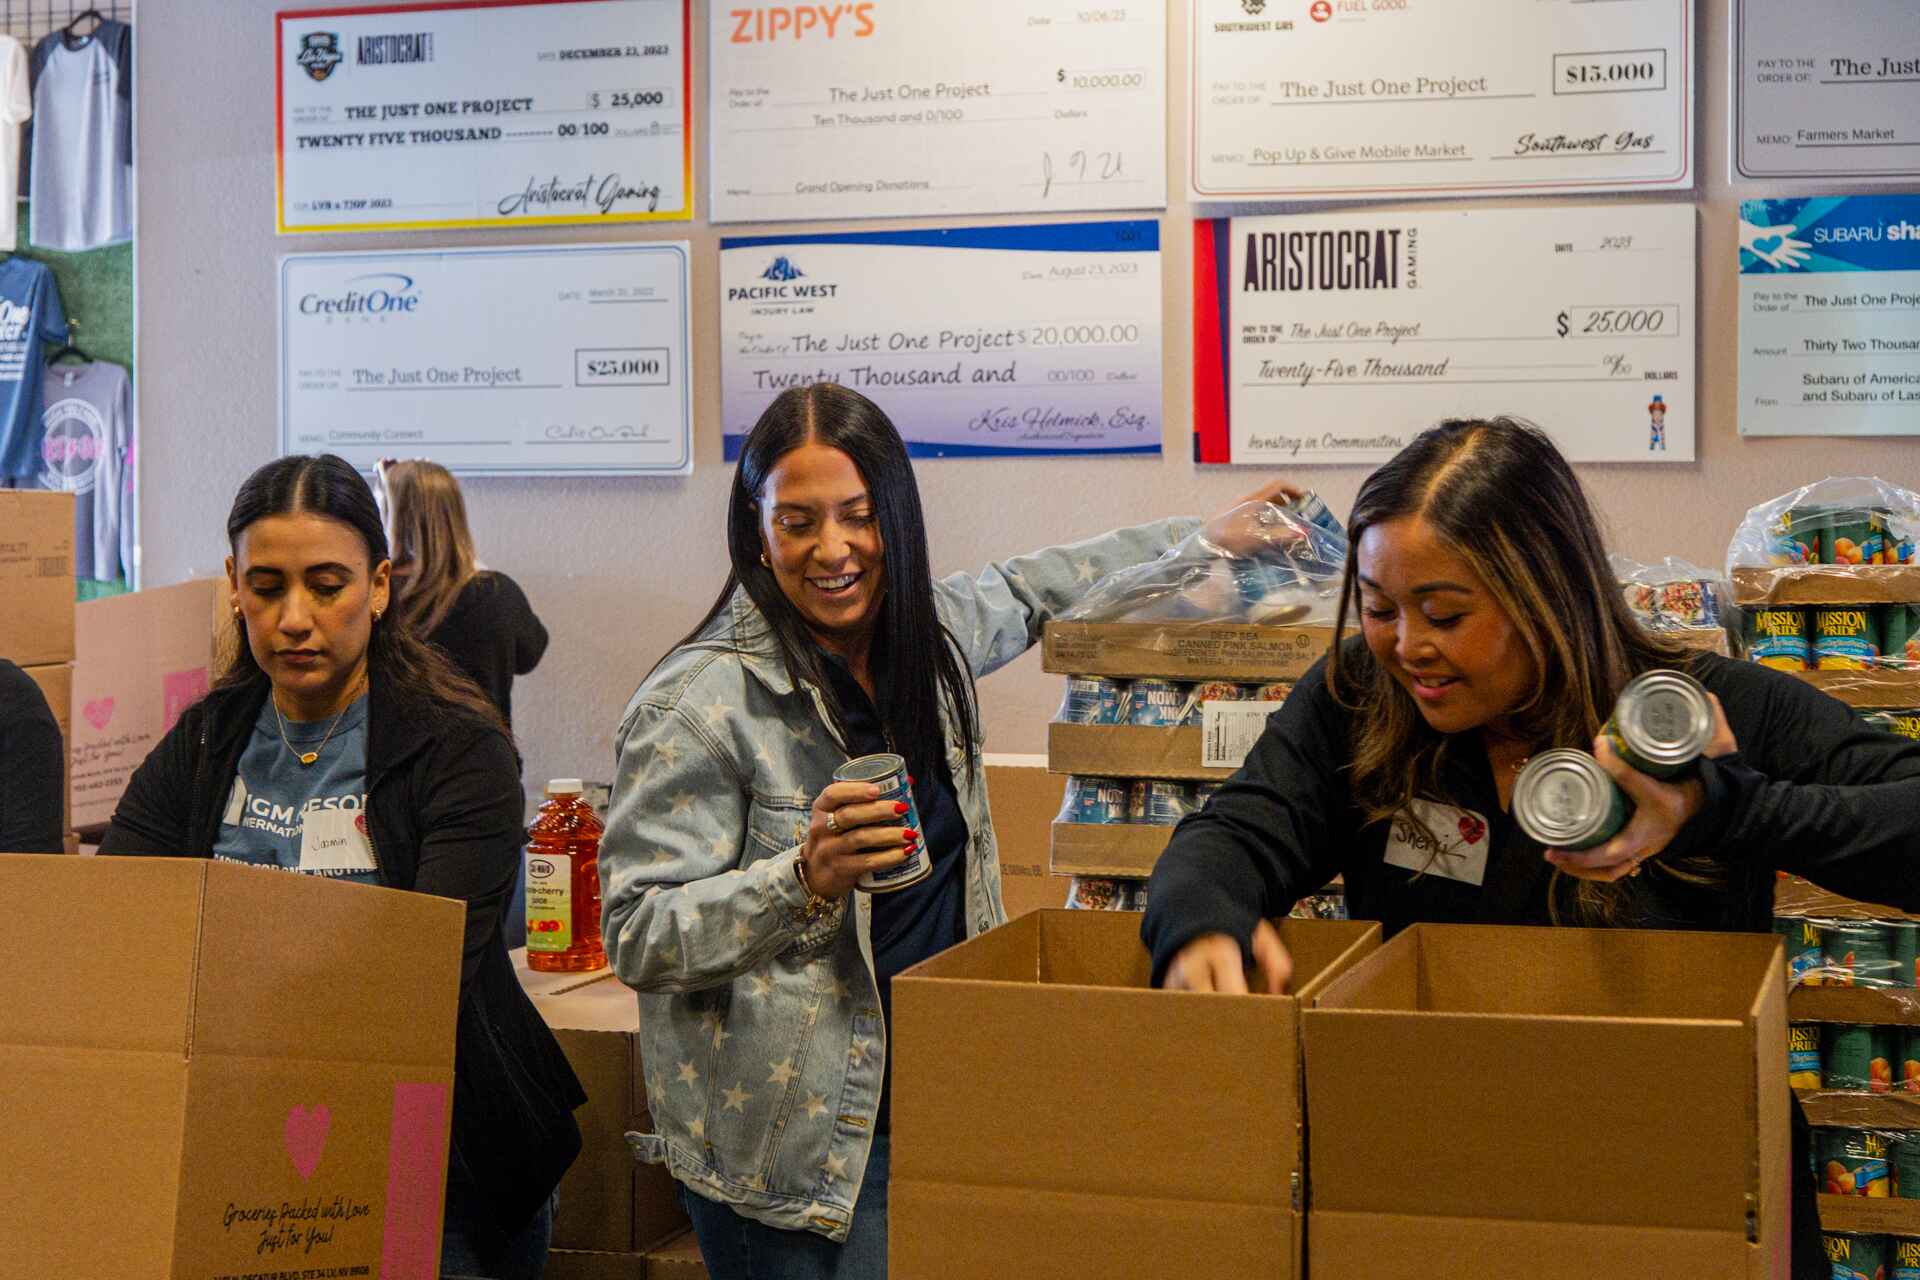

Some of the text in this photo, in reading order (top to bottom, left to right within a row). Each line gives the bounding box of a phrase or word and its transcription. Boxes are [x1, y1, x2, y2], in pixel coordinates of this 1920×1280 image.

[730, 3, 875, 43] ZIPPY'S
[356, 33, 426, 65] ARISTOCRAT
[560, 47, 622, 60] DECEMBER
[1758, 58, 1815, 68] PAY TO THE
[1830, 57, 1920, 76] The Just
[1057, 68, 1065, 82] $
[1757, 73, 1792, 83] ORDER
[829, 83, 991, 103] The Just One Project
[1280, 75, 1488, 98] The Just One Project
[344, 104, 377, 119] THE
[381, 103, 419, 120] JUST
[424, 102, 458, 117] ONE
[462, 97, 533, 115] PROJECT
[592, 93, 600, 108] $
[611, 92, 663, 108] 25,000
[813, 114, 835, 126] Ten
[838, 112, 897, 124] Thousand
[899, 110, 922, 122] and
[296, 127, 501, 149] TWENTY FIVE THOUSAND
[1514, 131, 1655, 155] Southwest Gas
[1797, 128, 1894, 141] Farmers Market
[1253, 142, 1466, 165] Pop Up & Give Mobile Market
[497, 173, 660, 215] Aristocrat Gaming
[795, 182, 826, 194] Grand
[830, 181, 874, 194] Opening
[876, 179, 929, 192] Donations
[1814, 225, 1882, 243] SUBARU
[1244, 228, 1418, 292] ARISTOCRAT GAMING
[728, 284, 837, 301] PACIFIC WEST
[1753, 292, 1798, 302] Pay to the
[1804, 295, 1828, 306] The
[1831, 294, 1857, 306] Just
[1861, 293, 1887, 305] One
[752, 307, 814, 316] INJURY LAW
[1753, 303, 1790, 312] Order of
[1290, 324, 1311, 338] The
[1315, 323, 1343, 338] Just
[1347, 322, 1372, 336] One
[1375, 322, 1420, 344] Project
[1557, 311, 1569, 338] $
[792, 334, 829, 353] The
[836, 333, 880, 352] Just
[888, 331, 929, 350] One
[939, 329, 1015, 353] Project
[1031, 324, 1138, 347] 20,000.00
[1804, 339, 1838, 353] Thirty
[1842, 339, 1866, 351] Two
[352, 368, 384, 385] The
[388, 368, 422, 385] Just
[426, 367, 458, 383] One
[463, 366, 522, 387] Project
[850, 362, 961, 386] Thousand
[971, 360, 1016, 383] and
[1258, 357, 1449, 387] Twenty-Five Thousand
[1803, 374, 1849, 386] Subaru
[1853, 373, 1867, 385] of
[1802, 391, 1827, 402] and
[1832, 390, 1877, 402] Subaru
[1882, 390, 1894, 401] of
[328, 431, 381, 442] Community
[384, 428, 423, 440] Connect
[1249, 433, 1402, 456] Investing in Communities
[1756, 611, 1805, 632] MISSION
[1767, 625, 1800, 636] PRIDE
[1817, 611, 1866, 632] MISSION
[1824, 626, 1856, 636] PRIDE
[1178, 640, 1292, 651] CANNED PINK SALMON
[296, 794, 368, 822] ESO
